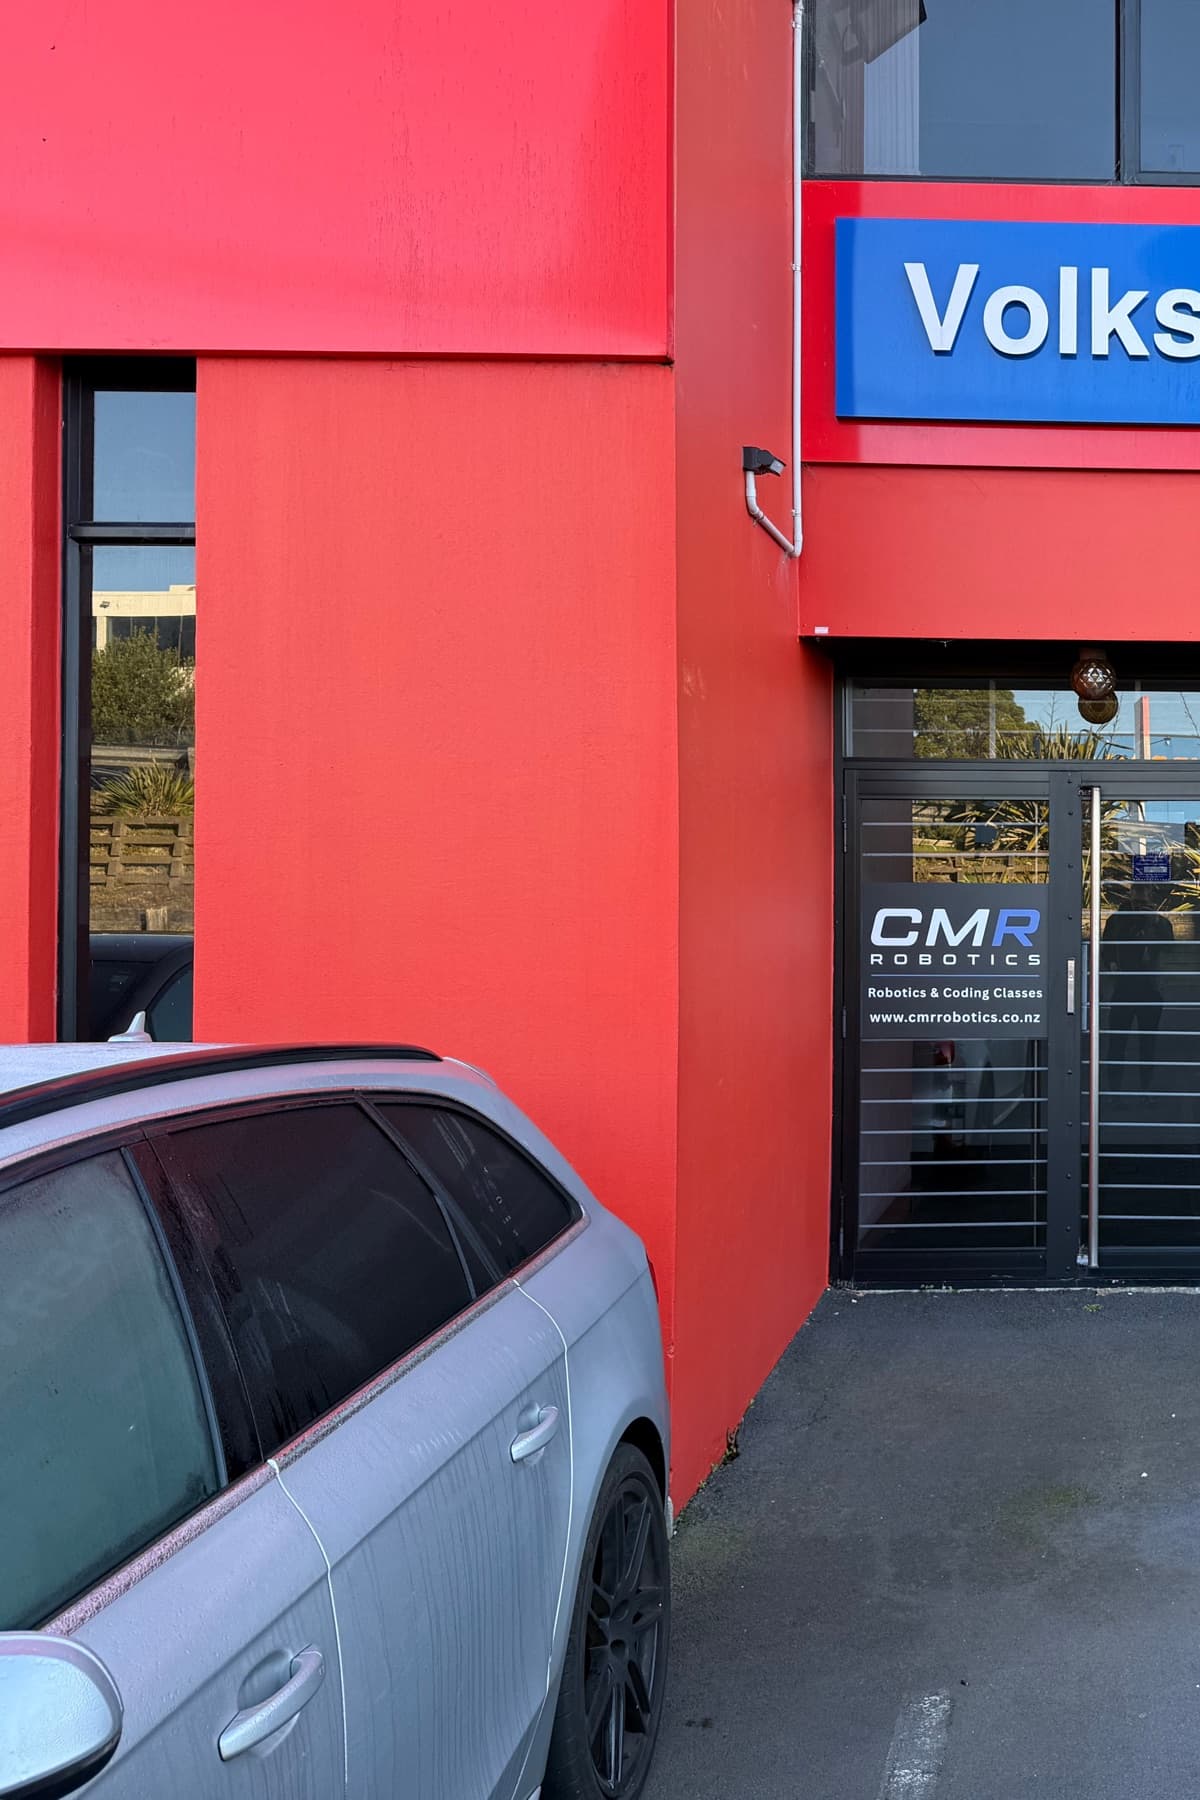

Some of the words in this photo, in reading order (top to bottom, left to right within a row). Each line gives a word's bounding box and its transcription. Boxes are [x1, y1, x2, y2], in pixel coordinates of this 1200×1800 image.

[870, 908, 1041, 947] CMR
[870, 953, 1041, 966] ROBOTICS
[868, 986, 927, 998] Robotics
[930, 988, 939, 998] &
[943, 986, 990, 1001] Coding
[993, 987, 1043, 998] Classes
[869, 1010, 1041, 1024] www.cmrrobotics.co.nz
